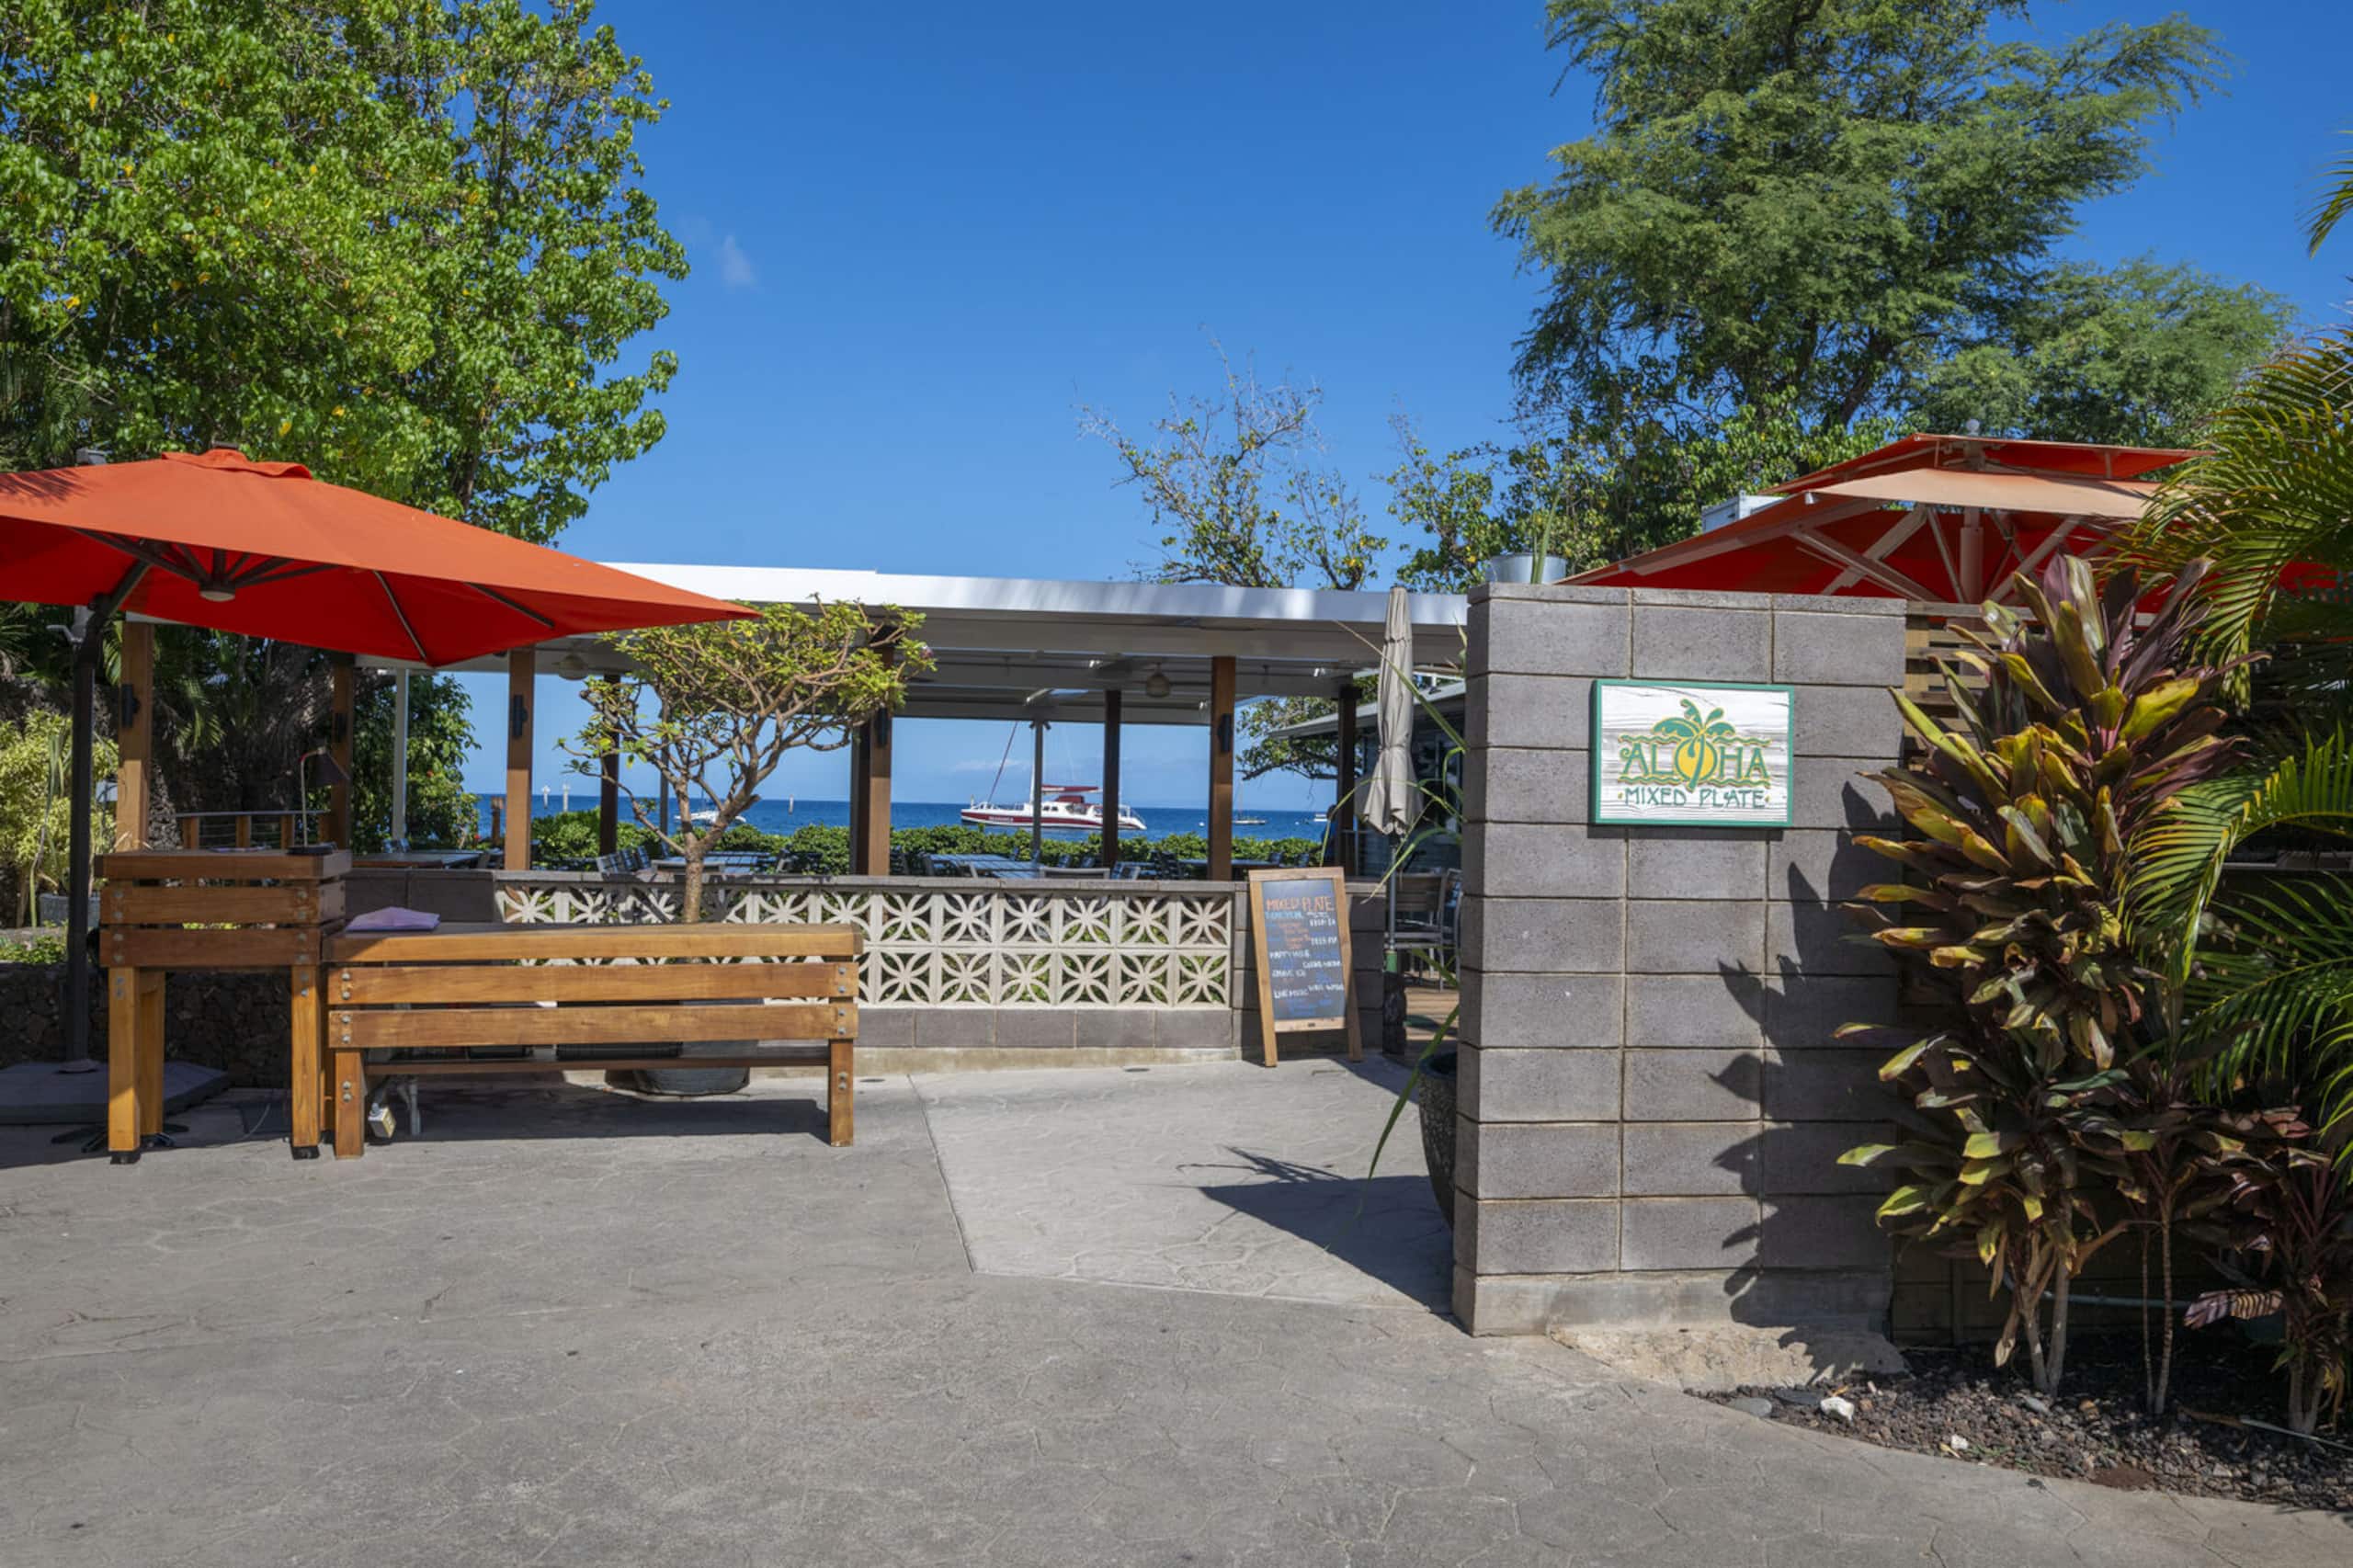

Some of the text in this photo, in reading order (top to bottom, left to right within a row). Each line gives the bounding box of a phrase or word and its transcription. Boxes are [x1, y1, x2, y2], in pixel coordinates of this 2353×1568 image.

[1620, 738, 1770, 780] ALOHA
[1625, 787, 1766, 809] MIXED PLATE
